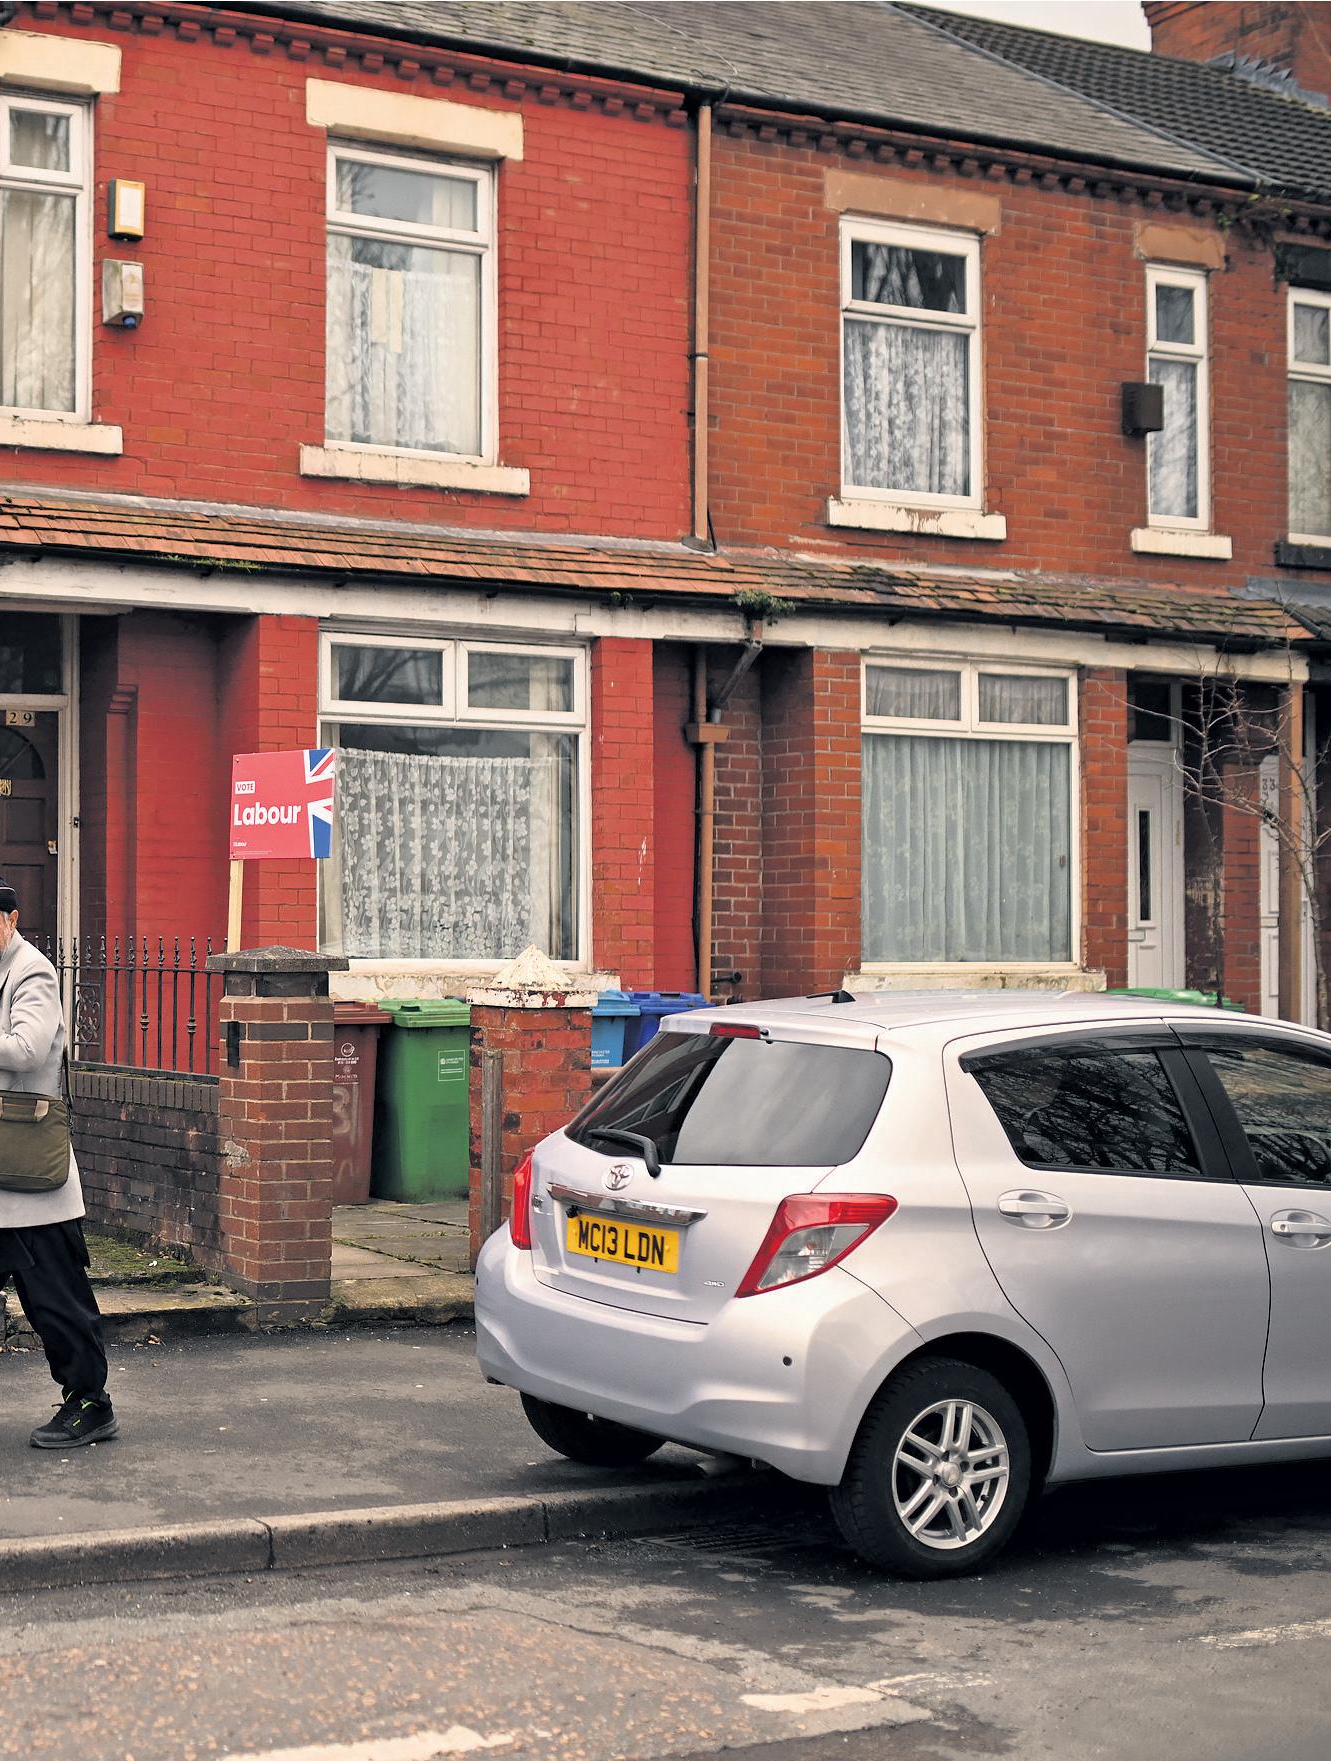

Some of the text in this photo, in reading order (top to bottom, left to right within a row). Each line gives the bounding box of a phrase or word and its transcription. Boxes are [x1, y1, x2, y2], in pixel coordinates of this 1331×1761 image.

[9, 712, 33, 724] 29
[236, 783, 254, 792] VOTE
[233, 802, 302, 826] Labour
[578, 1220, 665, 1266] MC13 LDN
